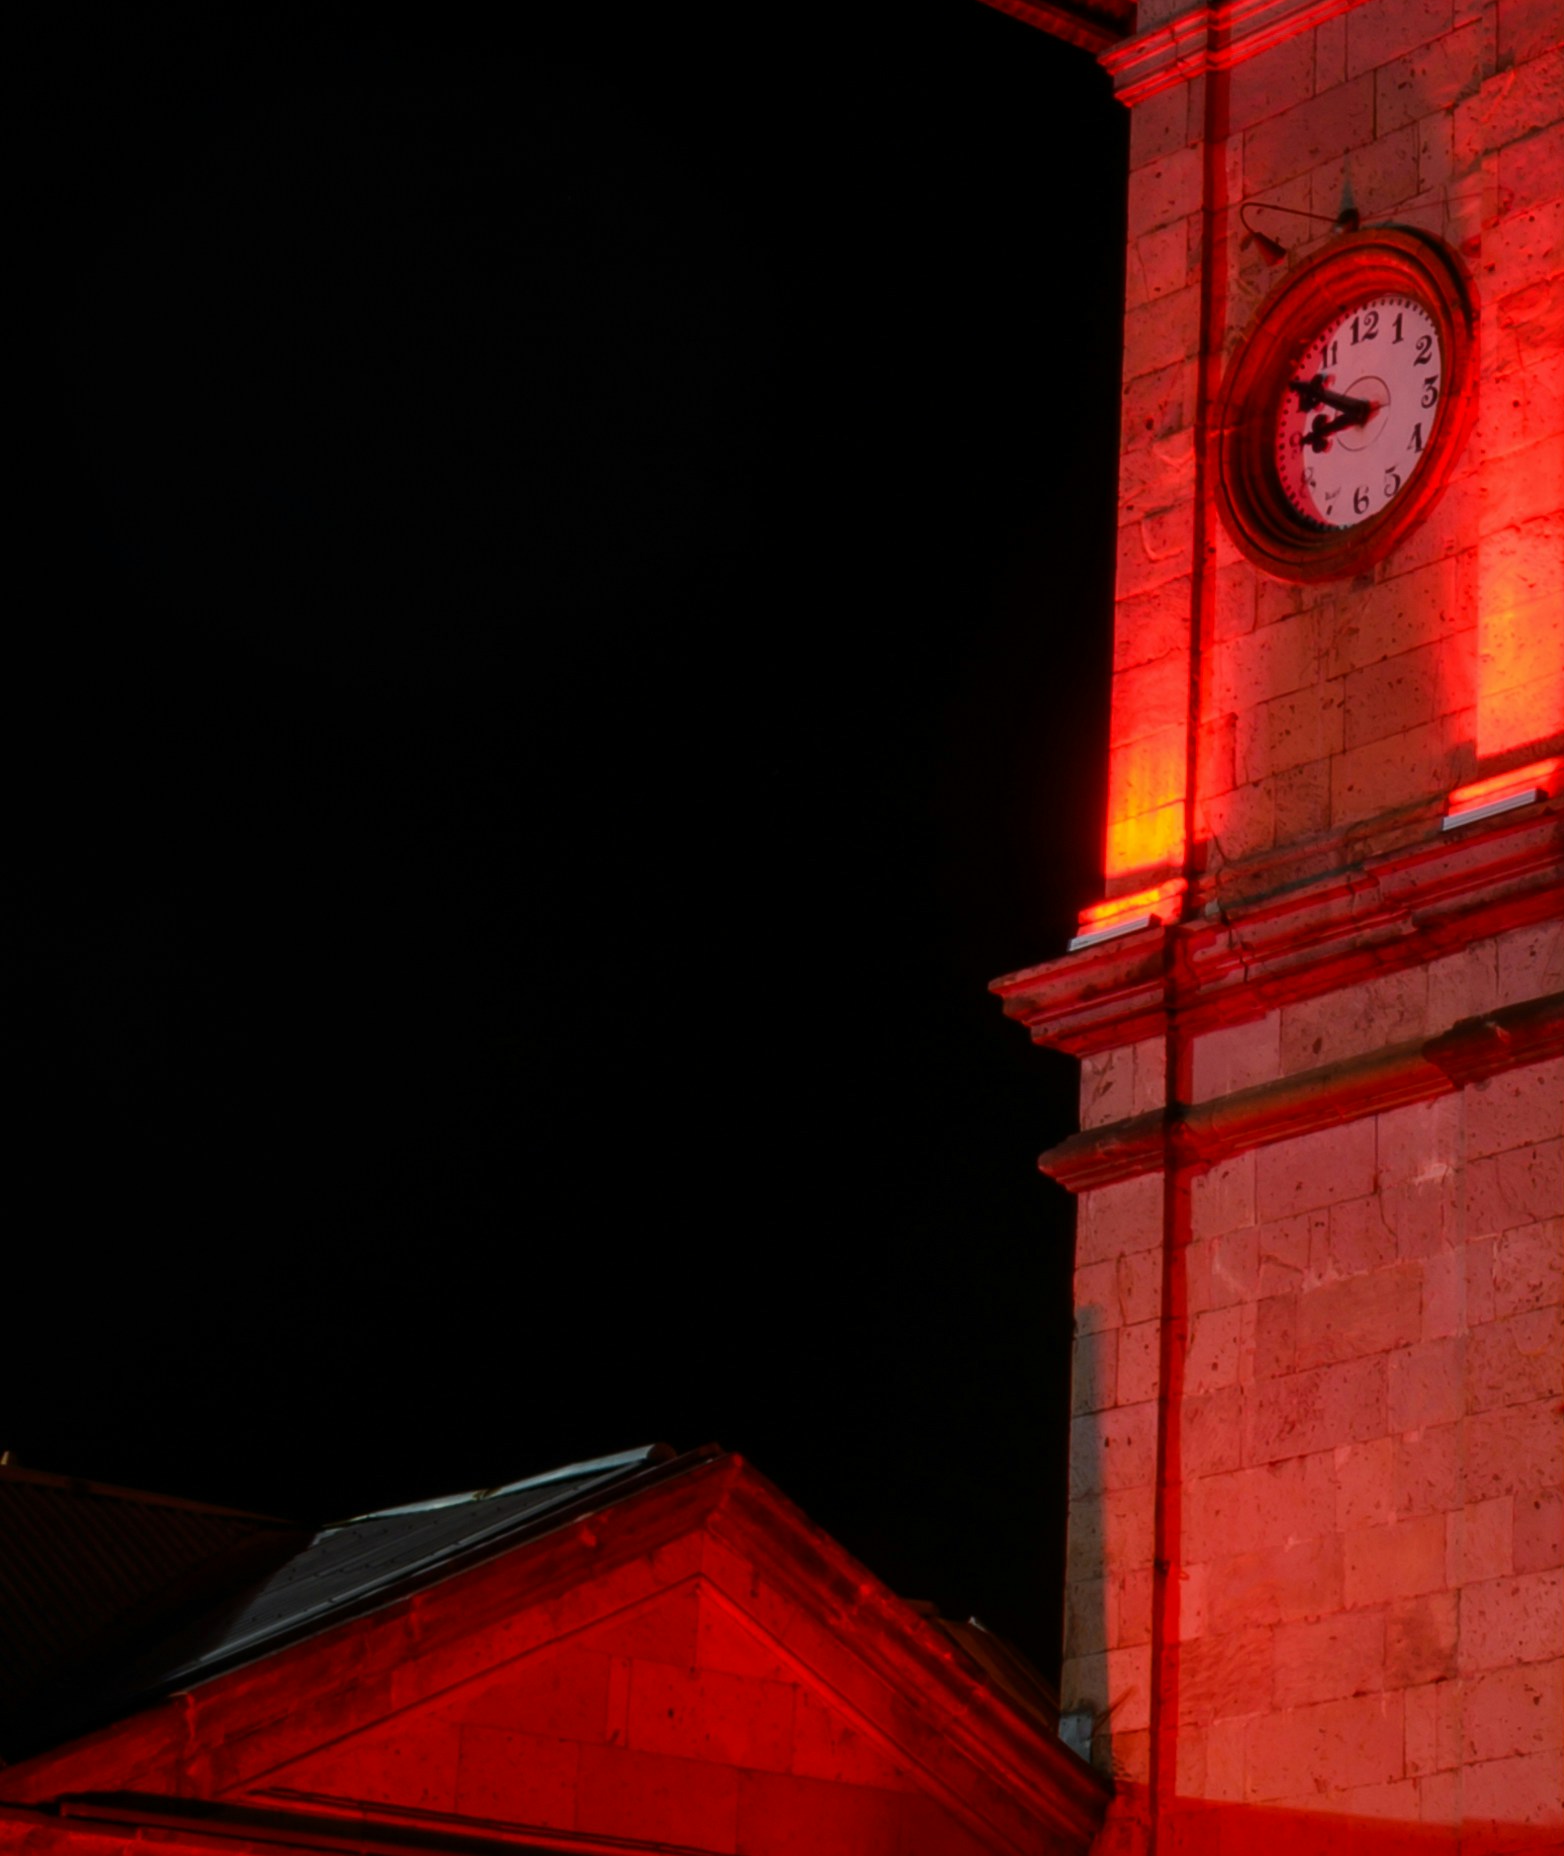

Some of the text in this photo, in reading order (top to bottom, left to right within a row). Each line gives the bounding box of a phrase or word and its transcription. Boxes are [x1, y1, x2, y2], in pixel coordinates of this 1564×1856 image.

[1350, 311, 1379, 346] 12
[1392, 313, 1404, 345] 1
[1321, 340, 1338, 370] 11
[1413, 334, 1433, 366] 2
[1421, 375, 1439, 409] 3
[1407, 422, 1424, 453] 4
[1384, 466, 1401, 497] 5
[1353, 486, 1370, 515] 6
